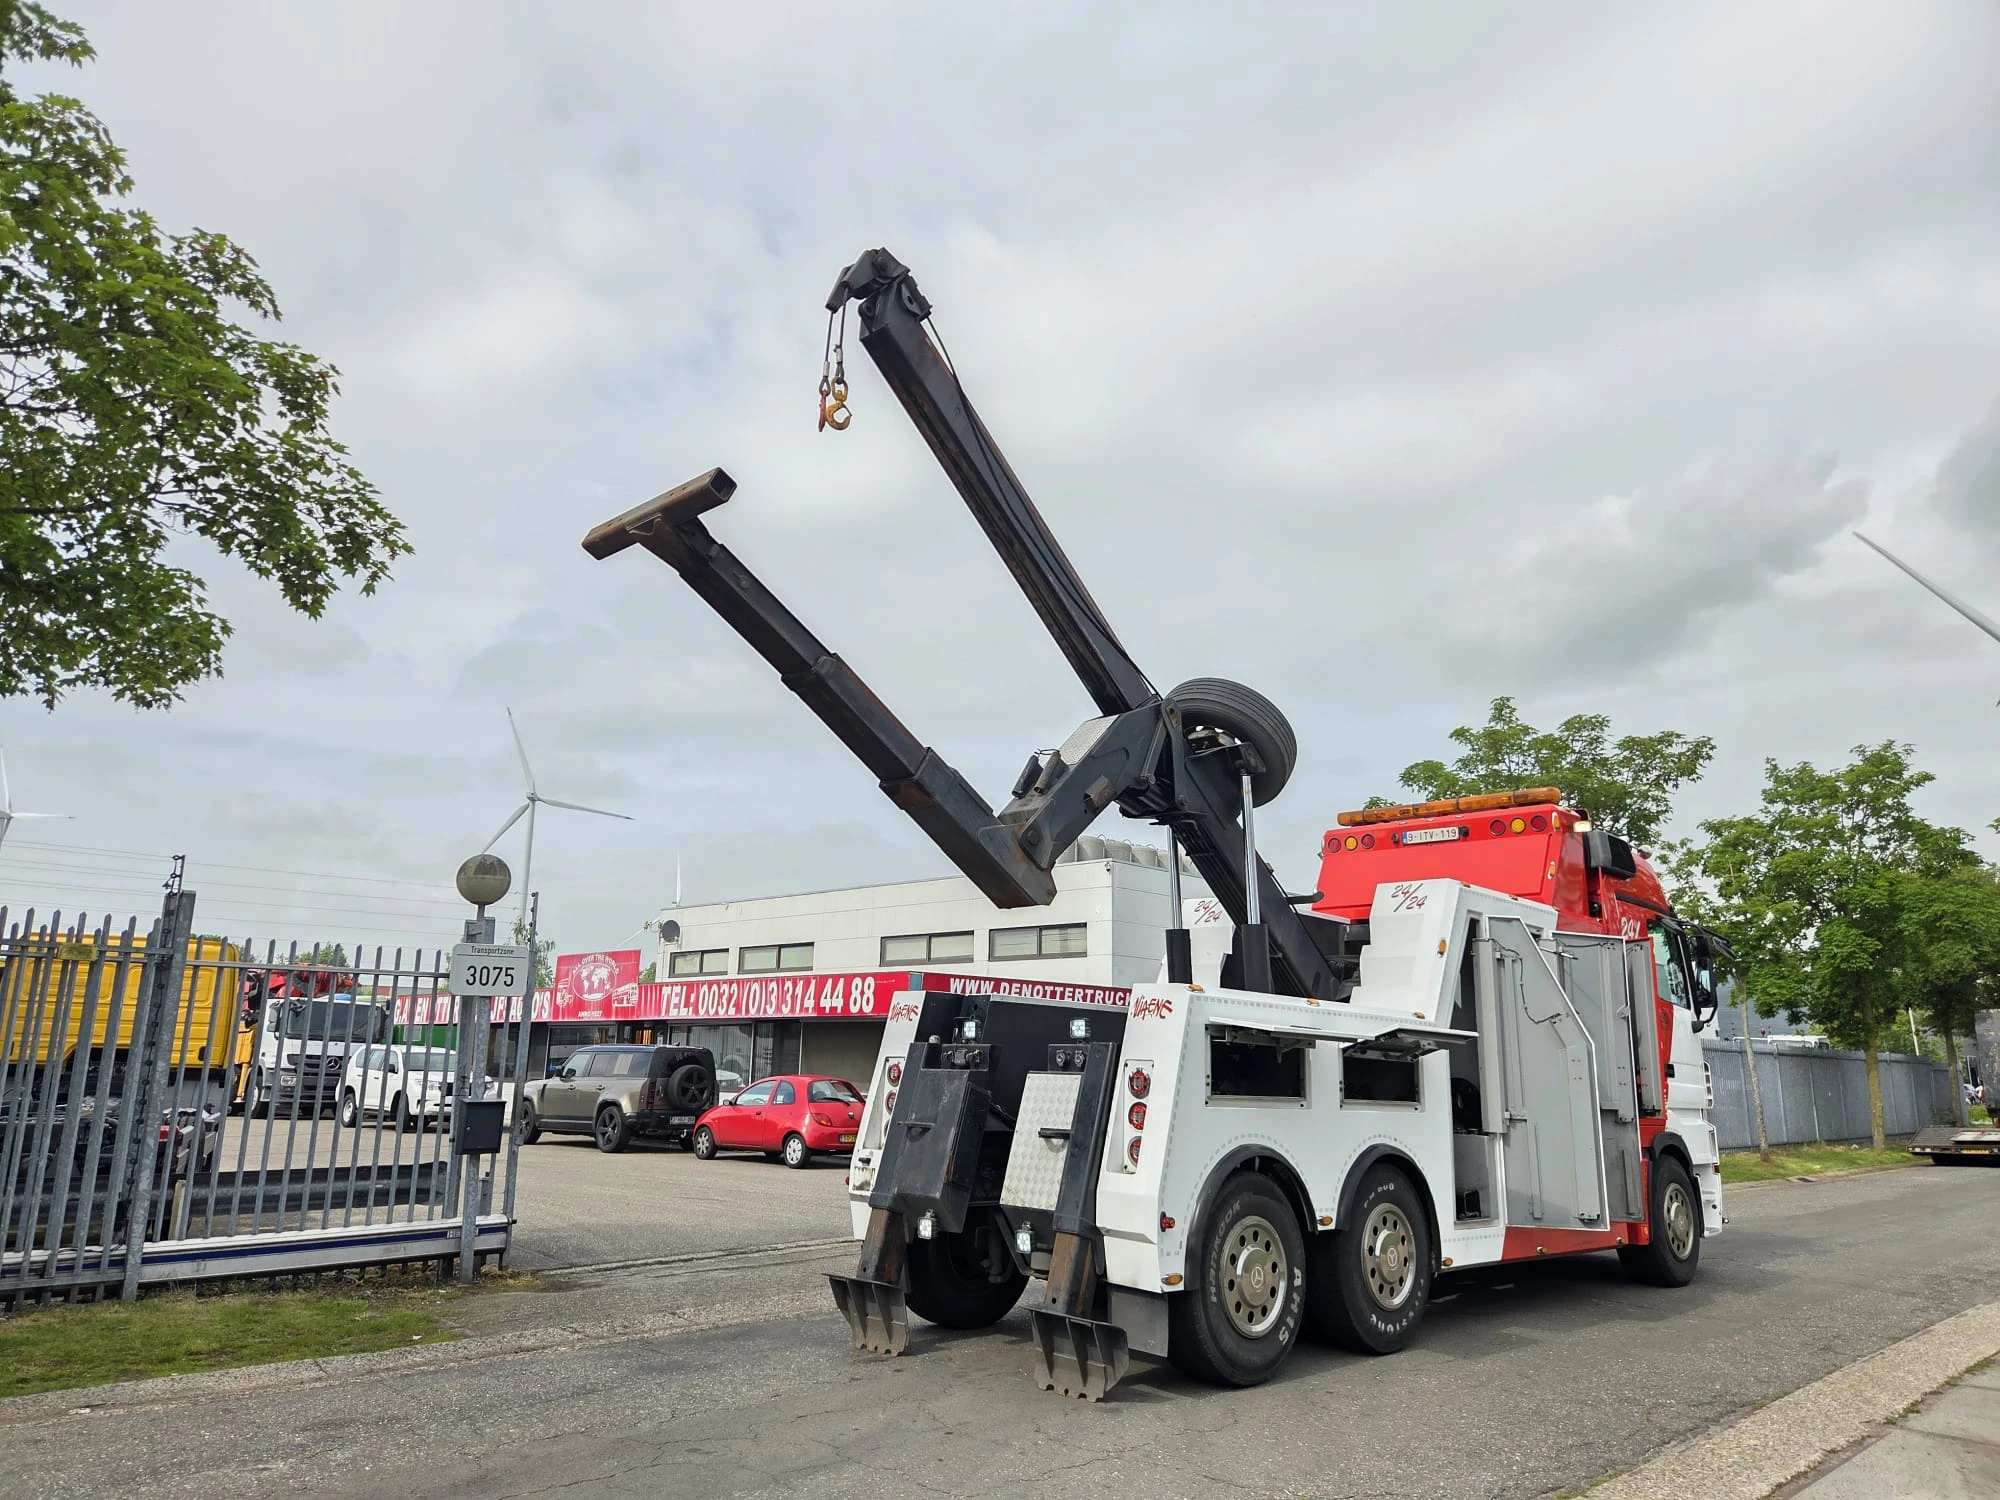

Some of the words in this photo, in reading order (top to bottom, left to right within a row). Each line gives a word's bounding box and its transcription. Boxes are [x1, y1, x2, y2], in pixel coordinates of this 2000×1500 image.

[471, 945, 515, 955] Transportzone
[465, 965, 515, 987] 3075
[661, 985, 695, 1016] TEL:
[698, 983, 738, 1016] 0032
[741, 981, 778, 1016] (0)3
[781, 979, 816, 1014] 314
[819, 977, 845, 1014] 44
[849, 976, 875, 1014] 88
